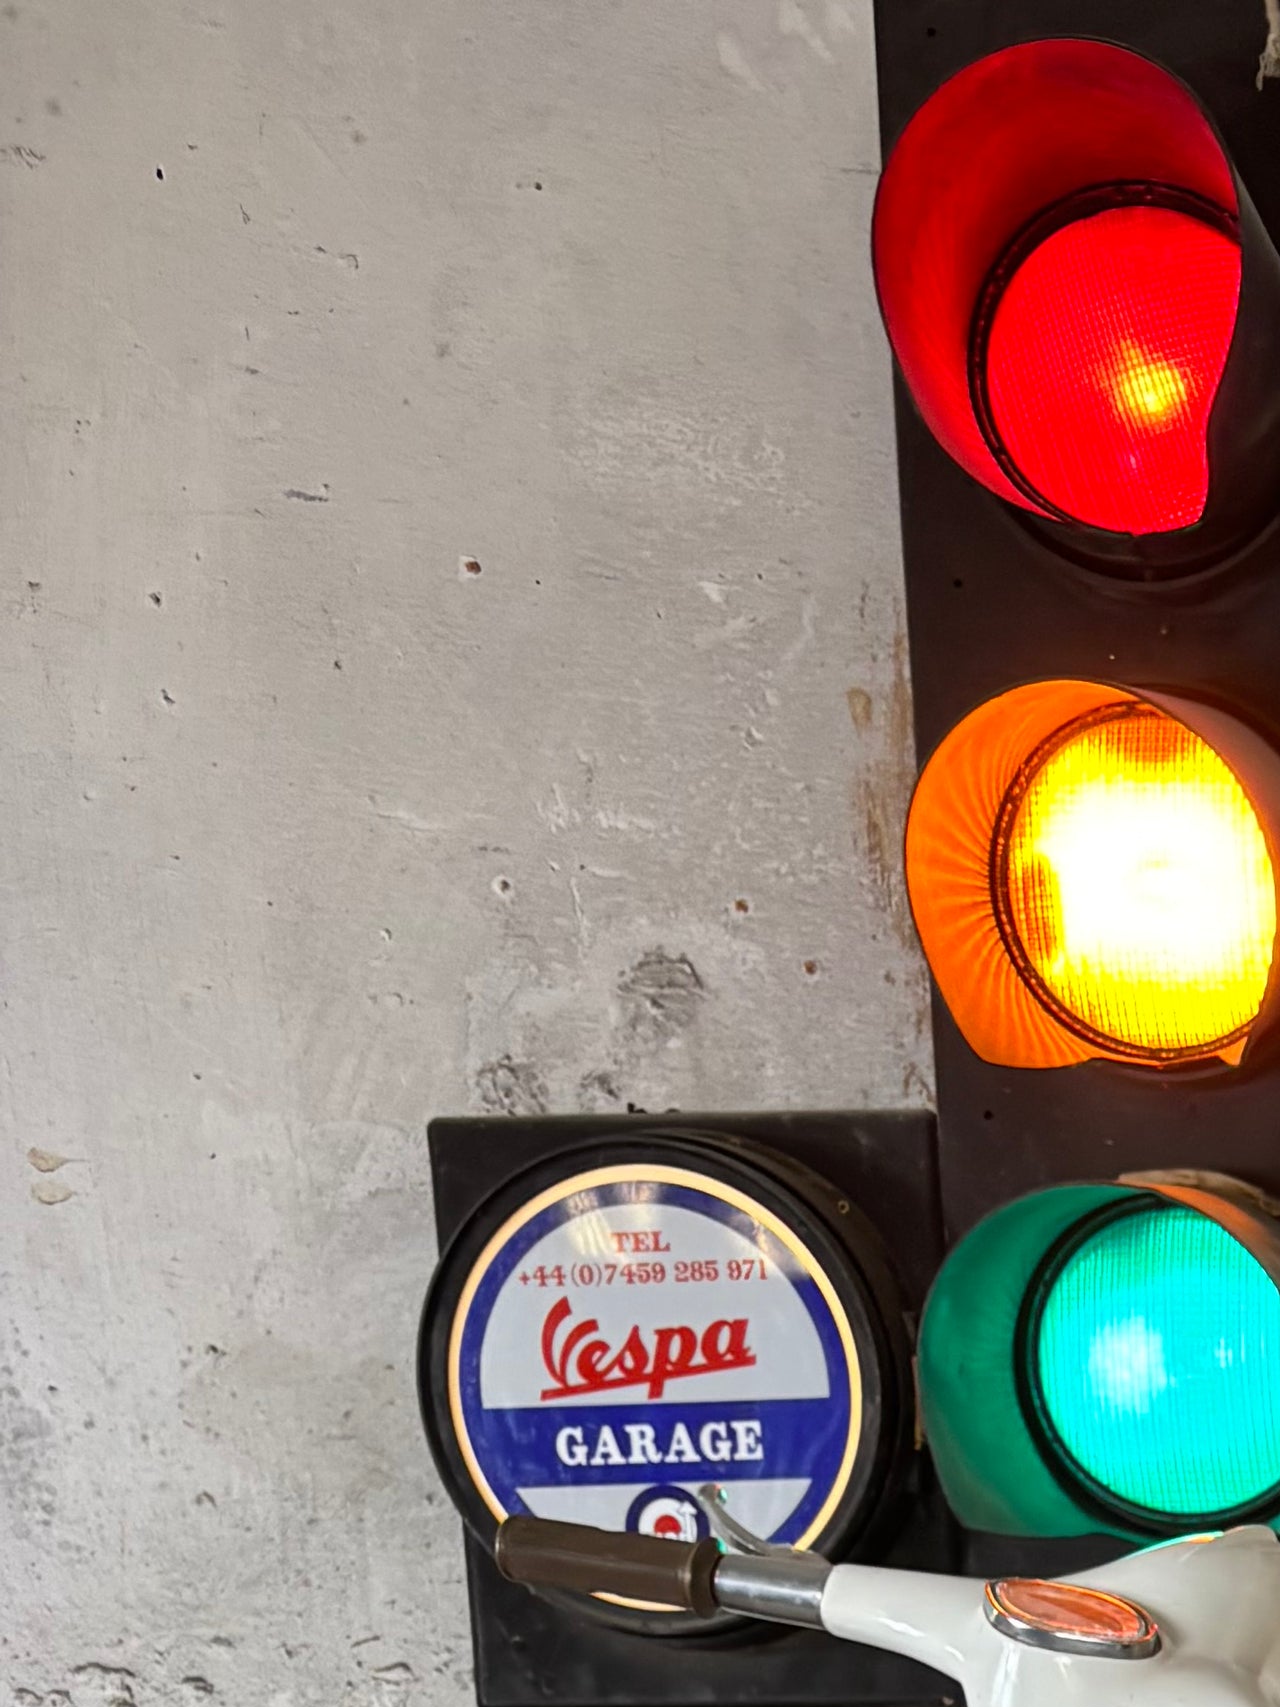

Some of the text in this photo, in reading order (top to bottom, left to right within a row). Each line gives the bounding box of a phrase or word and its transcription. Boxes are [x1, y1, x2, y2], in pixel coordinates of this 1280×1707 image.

[611, 1230, 671, 1252] TEL
[674, 1260, 719, 1283] 285
[727, 1258, 768, 1281] 971
[540, 1296, 757, 1401] Vespa
[555, 1420, 764, 1466] GARAGE
